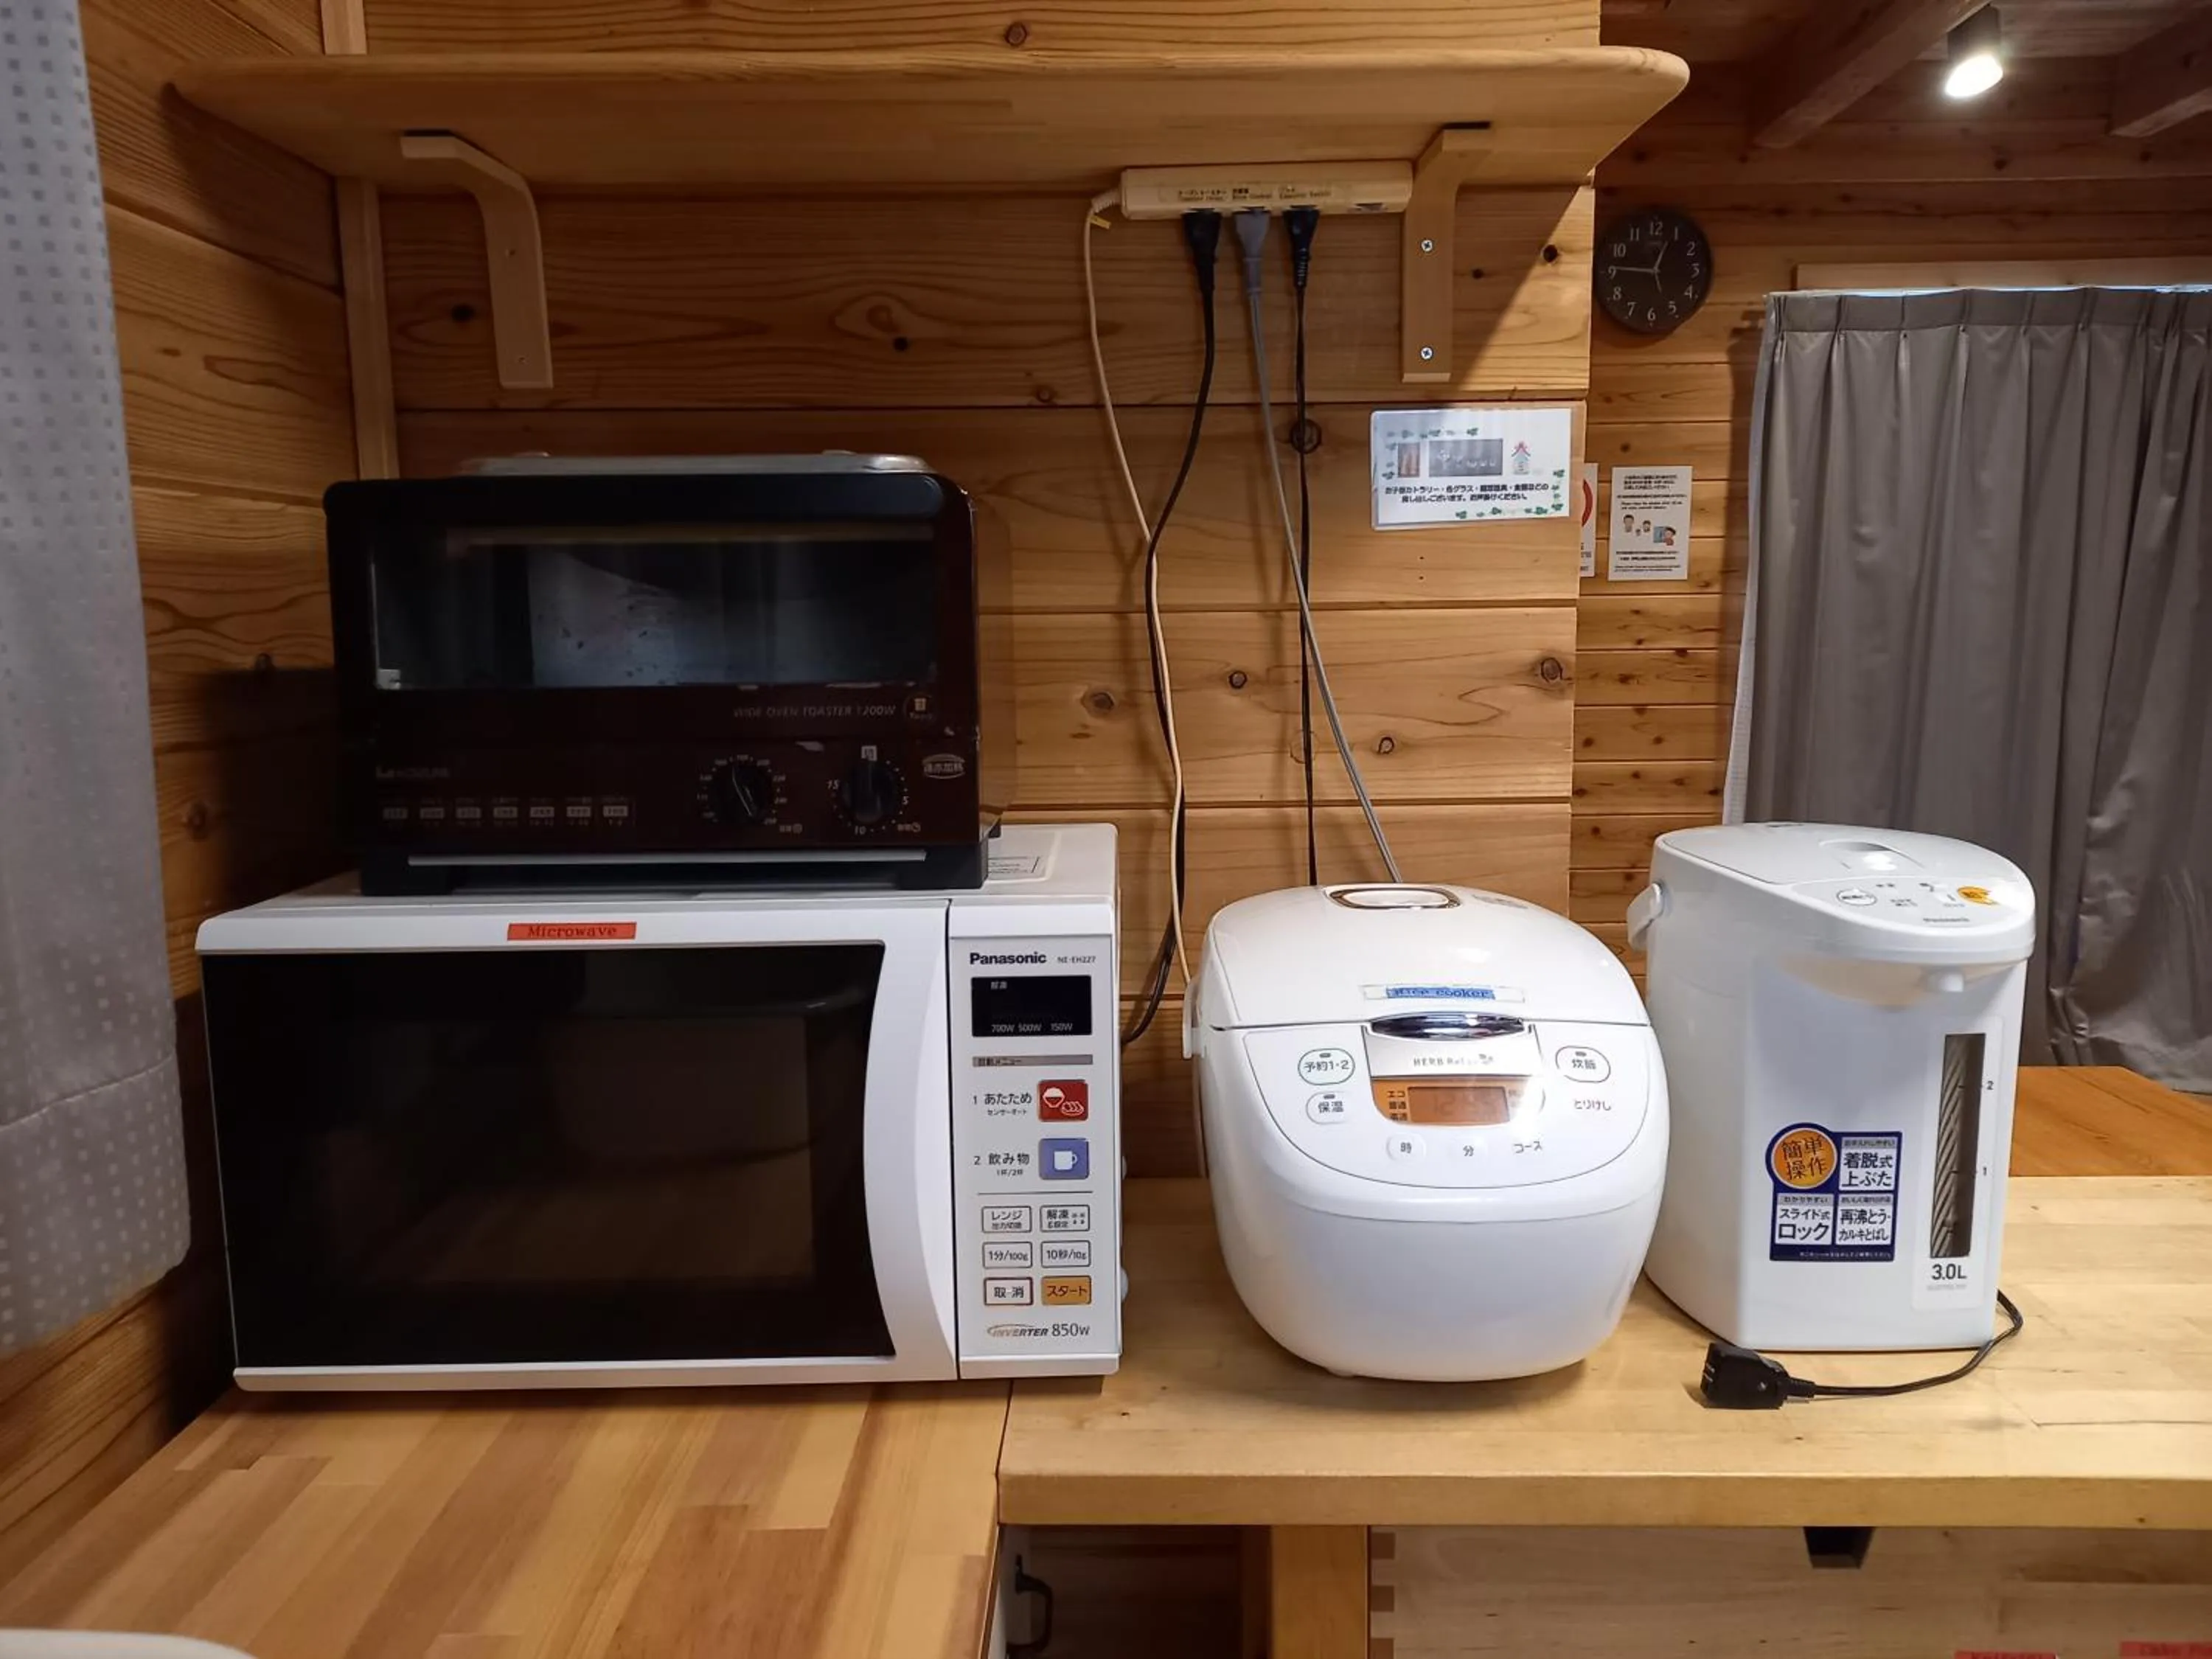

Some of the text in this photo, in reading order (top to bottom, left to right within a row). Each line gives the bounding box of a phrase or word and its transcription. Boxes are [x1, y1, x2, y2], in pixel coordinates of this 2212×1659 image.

[1630, 227, 1639, 241] 11
[1649, 221, 1663, 235] 12
[1674, 226, 1679, 240] 1
[1613, 243, 1627, 257] 10
[1686, 242, 1695, 256] 2
[1608, 265, 1617, 279] 9
[1691, 263, 1700, 278] 3
[1613, 287, 1622, 301] 8
[1684, 285, 1693, 299] 4
[1627, 302, 1636, 316] 7
[1647, 307, 1656, 321] 6
[1669, 301, 1677, 315] 5
[765, 706, 799, 717] OVEN
[803, 705, 852, 717] TOASTER
[857, 704, 896, 716] 1200W
[901, 796, 910, 805] 5
[854, 825, 867, 835] 10
[528, 925, 617, 937] Microwave
[970, 951, 1047, 965] Panasonic
[1438, 988, 1489, 998] cooker
[1413, 1057, 1444, 1067] HERB
[1571, 1059, 1597, 1071] 炊飯
[1986, 1080, 1994, 1091] 2
[984, 1092, 1032, 1106] あたため
[1573, 1099, 1611, 1111] とりけし
[1318, 1101, 1343, 1113] 保温
[1401, 1142, 1412, 1153] 時
[1463, 1144, 1474, 1157] 分
[1514, 1140, 1543, 1152] コース
[1781, 1137, 1823, 1161] 簡単
[974, 1152, 1030, 1166] 2 飲み物
[1843, 1152, 1893, 1169] 着脱式
[1785, 1157, 1828, 1180] 操作
[1983, 1166, 1988, 1175] 1
[1841, 1171, 1892, 1187] 上ぶた
[991, 1210, 1023, 1220] レンジ
[1046, 1209, 1069, 1221] 解凍
[1779, 1208, 1830, 1220] スライド式
[1778, 1222, 1829, 1241] ロック
[1838, 1227, 1889, 1242] カルキとばし
[989, 1250, 1029, 1262] 1分/100g
[1046, 1249, 1086, 1261] 10秒/10g
[1931, 1263, 1967, 1280] 3.0L
[1046, 1284, 1088, 1298] スタート
[991, 1327, 1048, 1338] INVERTER
